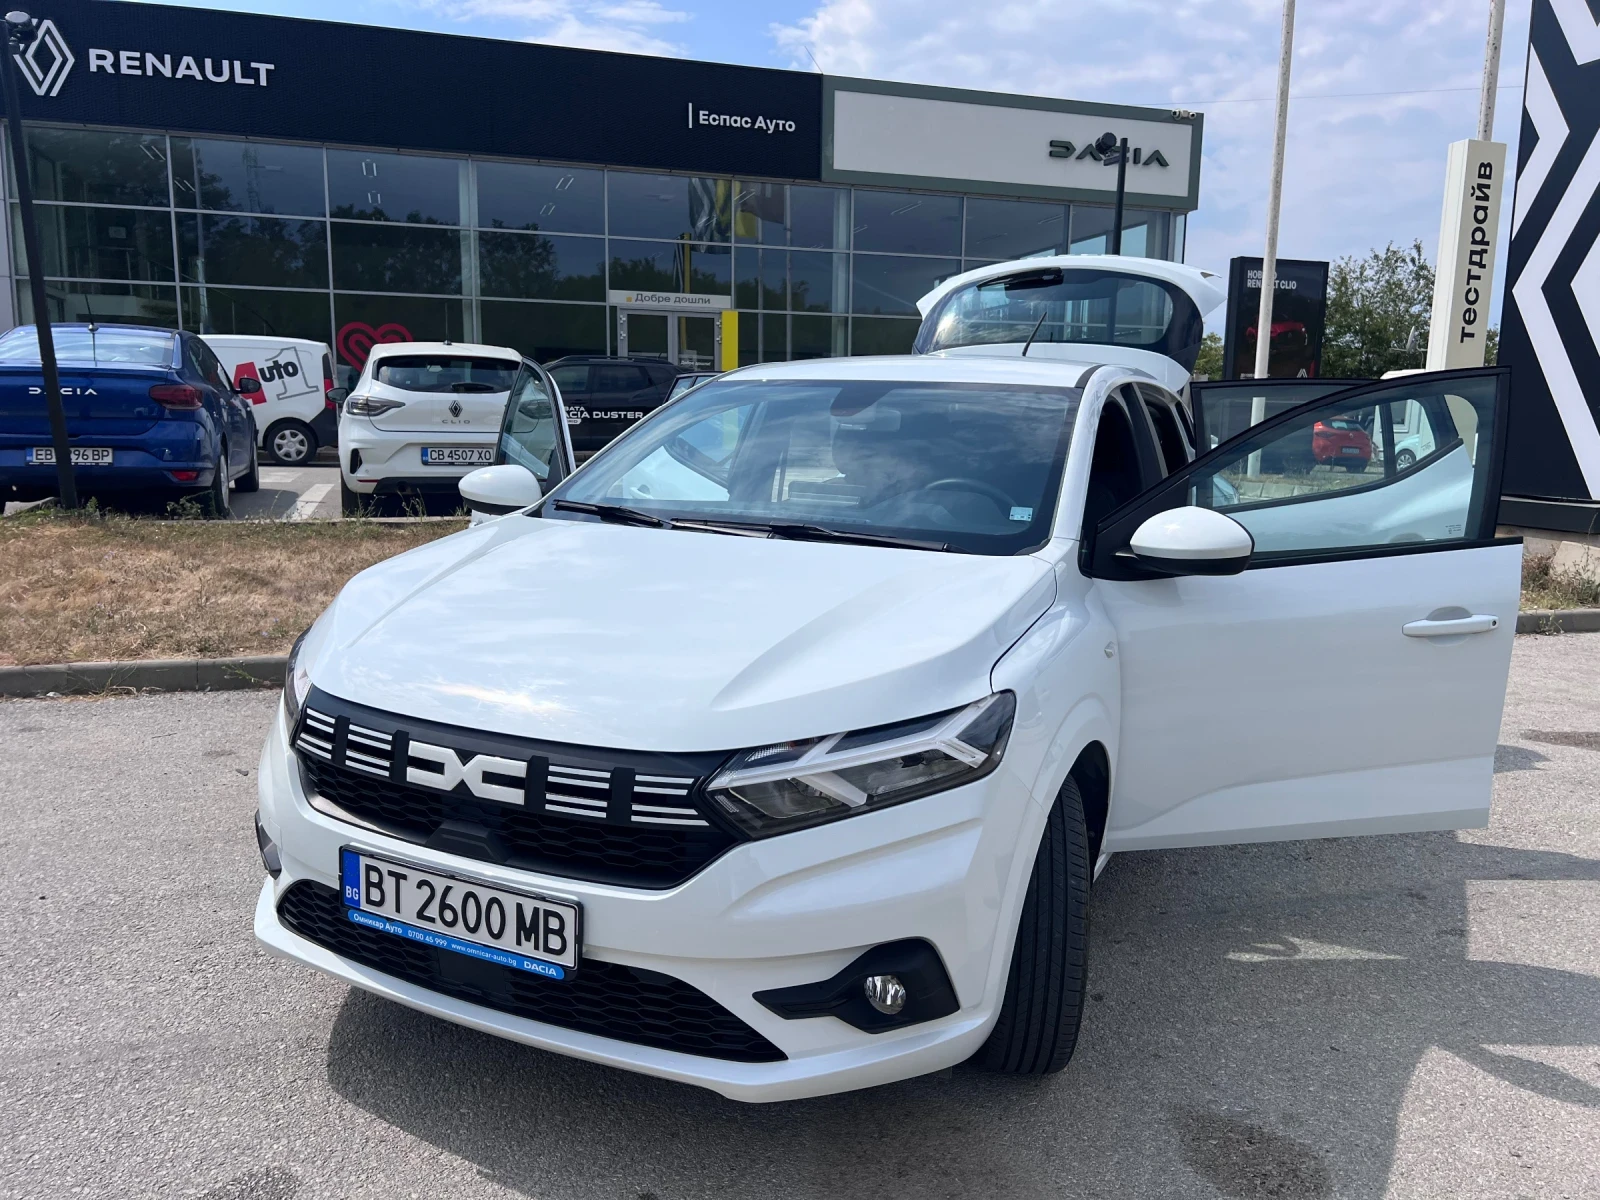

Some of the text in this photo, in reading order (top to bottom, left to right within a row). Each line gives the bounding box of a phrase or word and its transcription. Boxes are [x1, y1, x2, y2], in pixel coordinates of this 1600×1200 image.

[88, 48, 275, 87] RENAULT
[699, 110, 796, 134] Еспас Ауто
[1460, 161, 1493, 343] тестдрайв
[1247, 269, 1278, 280] НОВО
[1247, 279, 1297, 290] RENT CLIO
[635, 293, 711, 305] Добре дошли
[28, 387, 98, 395] DCIA
[592, 411, 644, 419] DUSTER
[35, 449, 53, 461] EB
[91, 449, 110, 461] BP
[430, 449, 445, 461] CB
[447, 449, 475, 461] 4507
[476, 450, 492, 461] XO
[345, 885, 359, 901] BG
[364, 863, 568, 956] BT 2600 MB
[353, 913, 557, 976] Омникар Ауто 0700 45 999 www.omnicar-auto.bg DACIA
